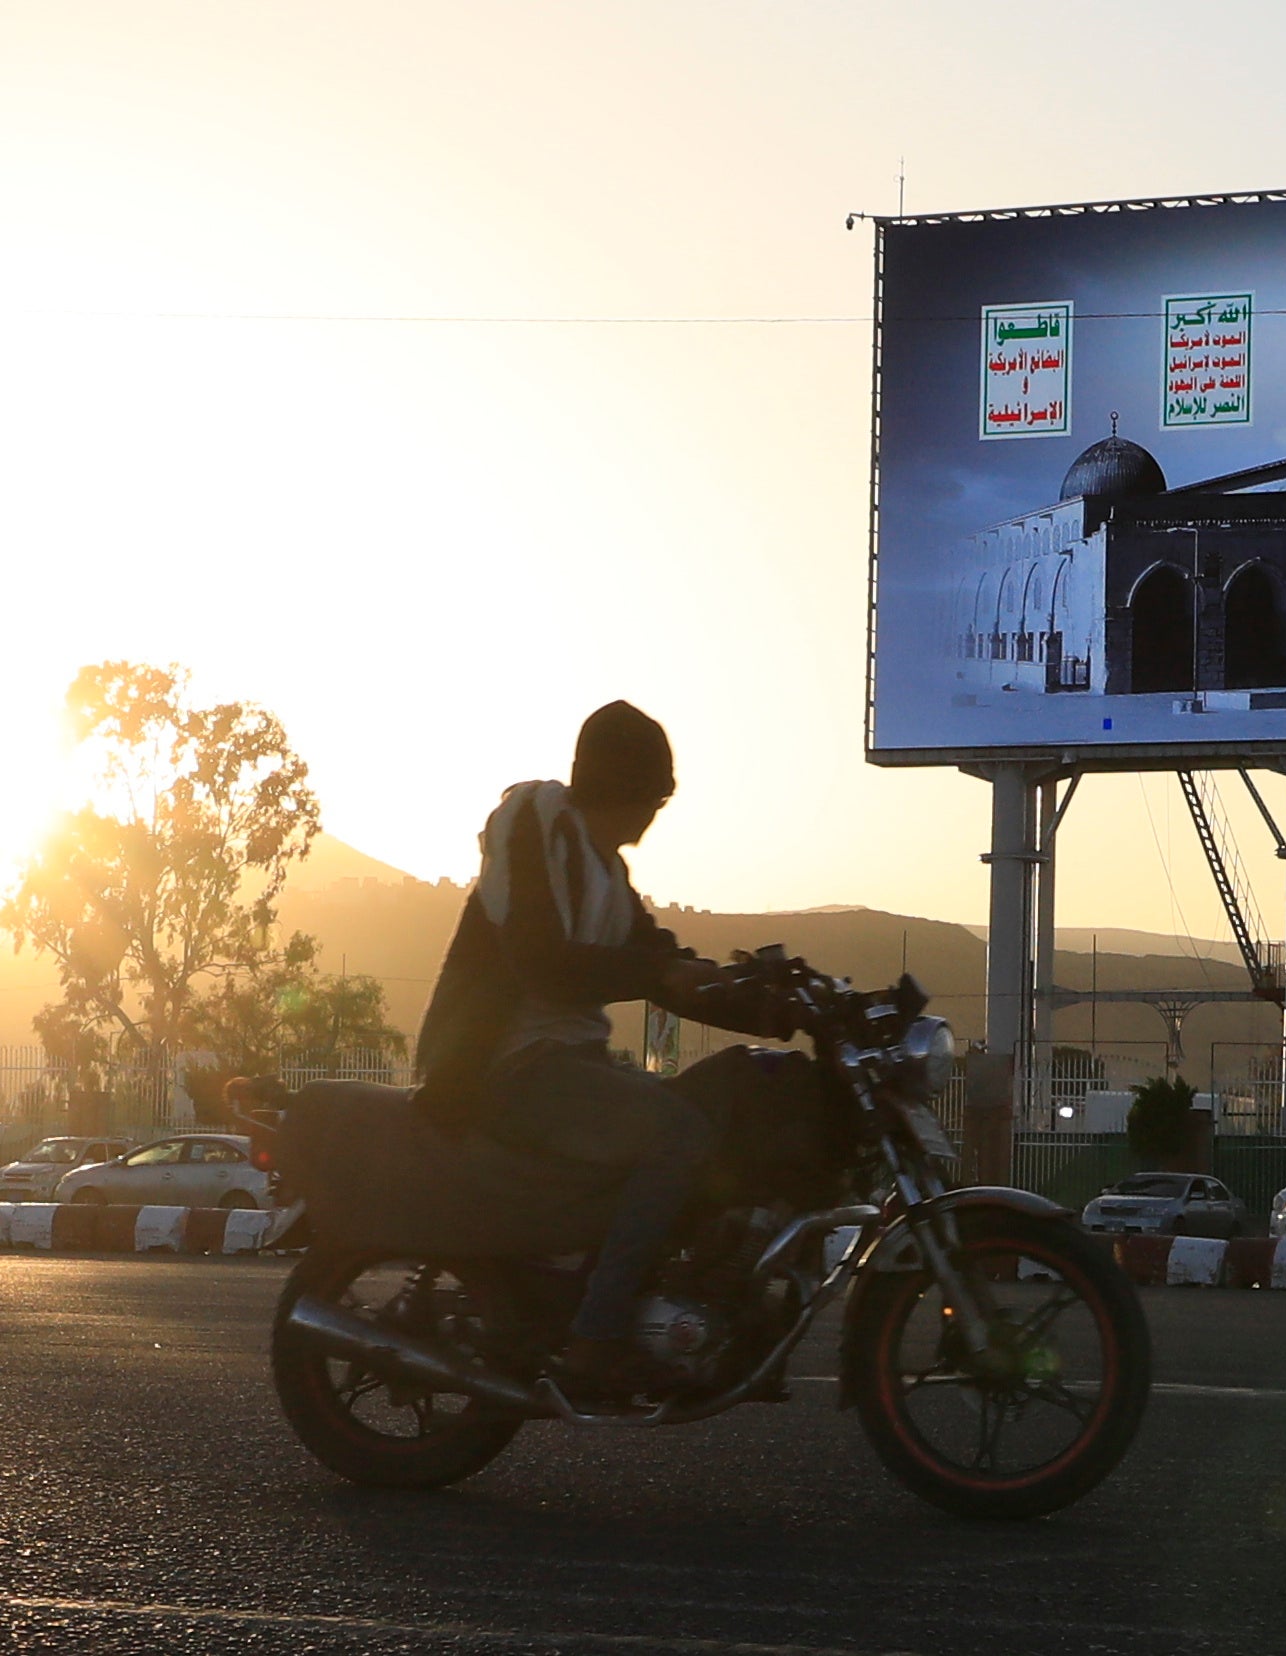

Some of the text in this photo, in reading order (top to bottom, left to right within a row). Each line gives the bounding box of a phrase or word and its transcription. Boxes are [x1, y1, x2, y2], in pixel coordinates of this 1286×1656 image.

[1170, 301, 1247, 332] الله أكبر
[993, 313, 1060, 346] قاطعوا
[1212, 331, 1246, 348] الموت
[1030, 348, 1064, 374] البضائع
[1212, 353, 1246, 370] الموت
[1022, 375, 1029, 395] و
[1169, 374, 1245, 395] اللعنة على اليهود
[1168, 393, 1245, 420] النصر للإسلام
